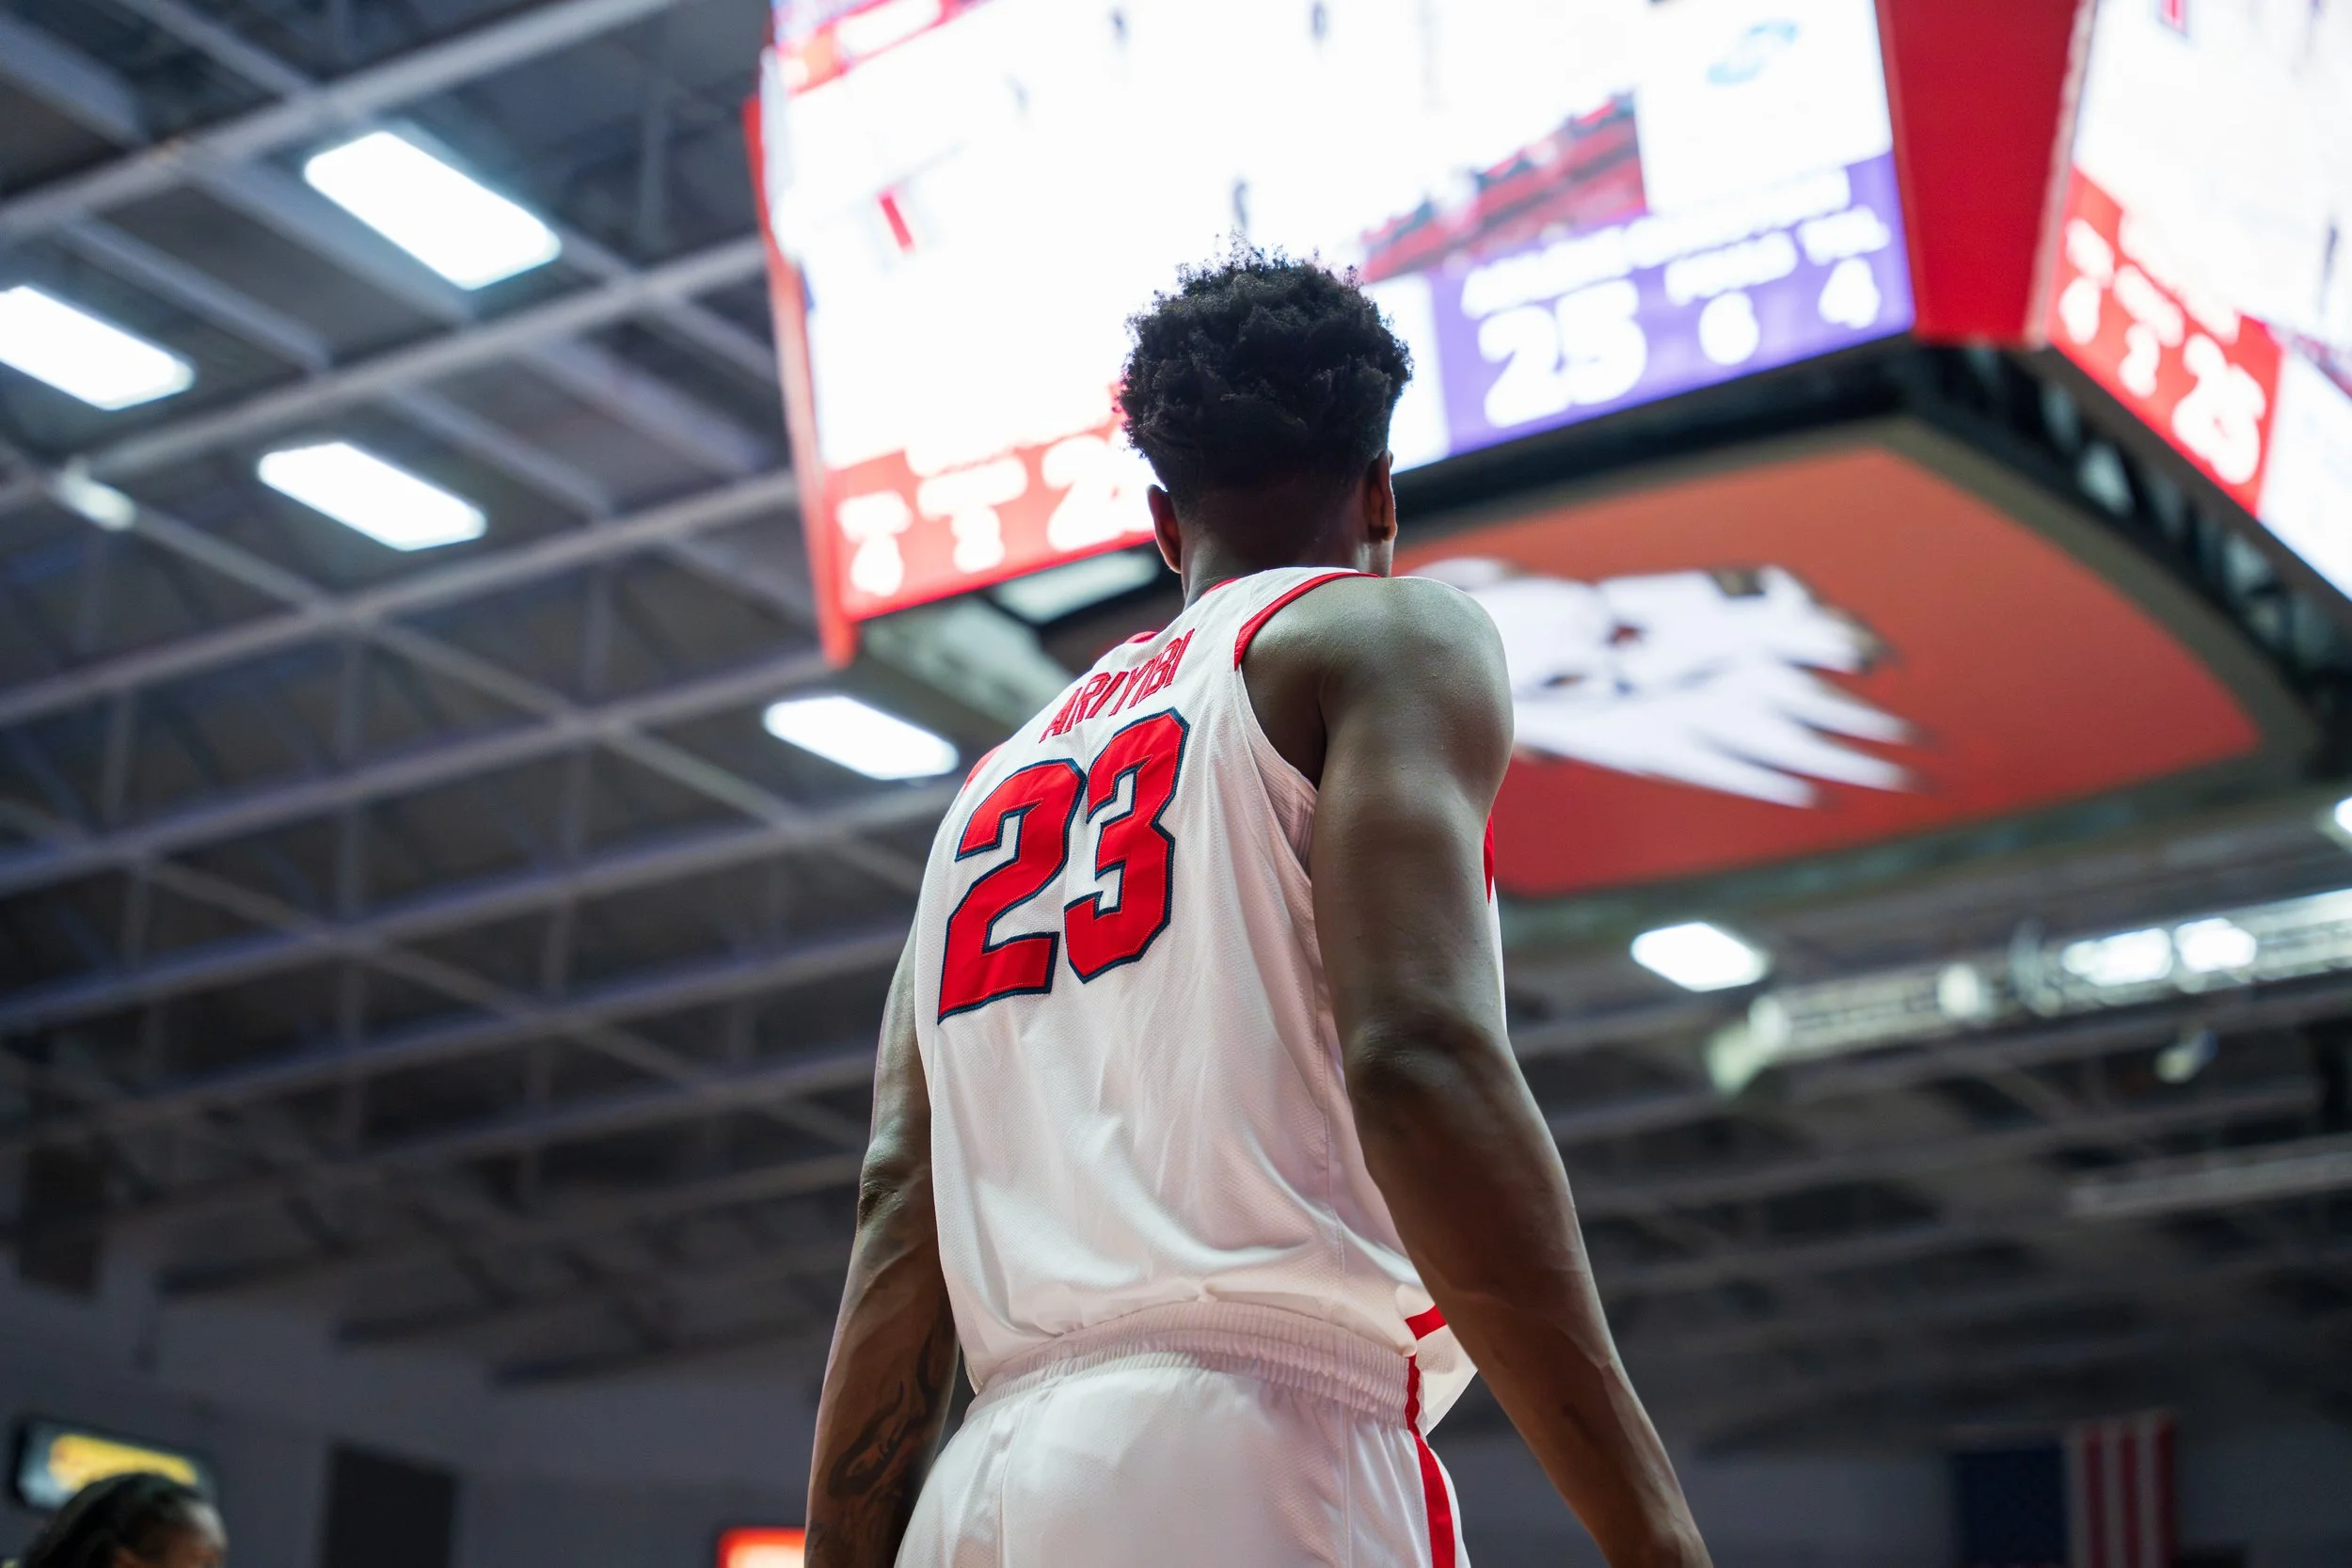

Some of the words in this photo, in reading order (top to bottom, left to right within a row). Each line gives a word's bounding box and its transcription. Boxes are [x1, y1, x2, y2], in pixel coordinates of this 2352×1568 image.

[1478, 278, 1646, 428] 25
[1038, 627, 1196, 744] ARIYIBI
[937, 705, 1190, 1025] 23
